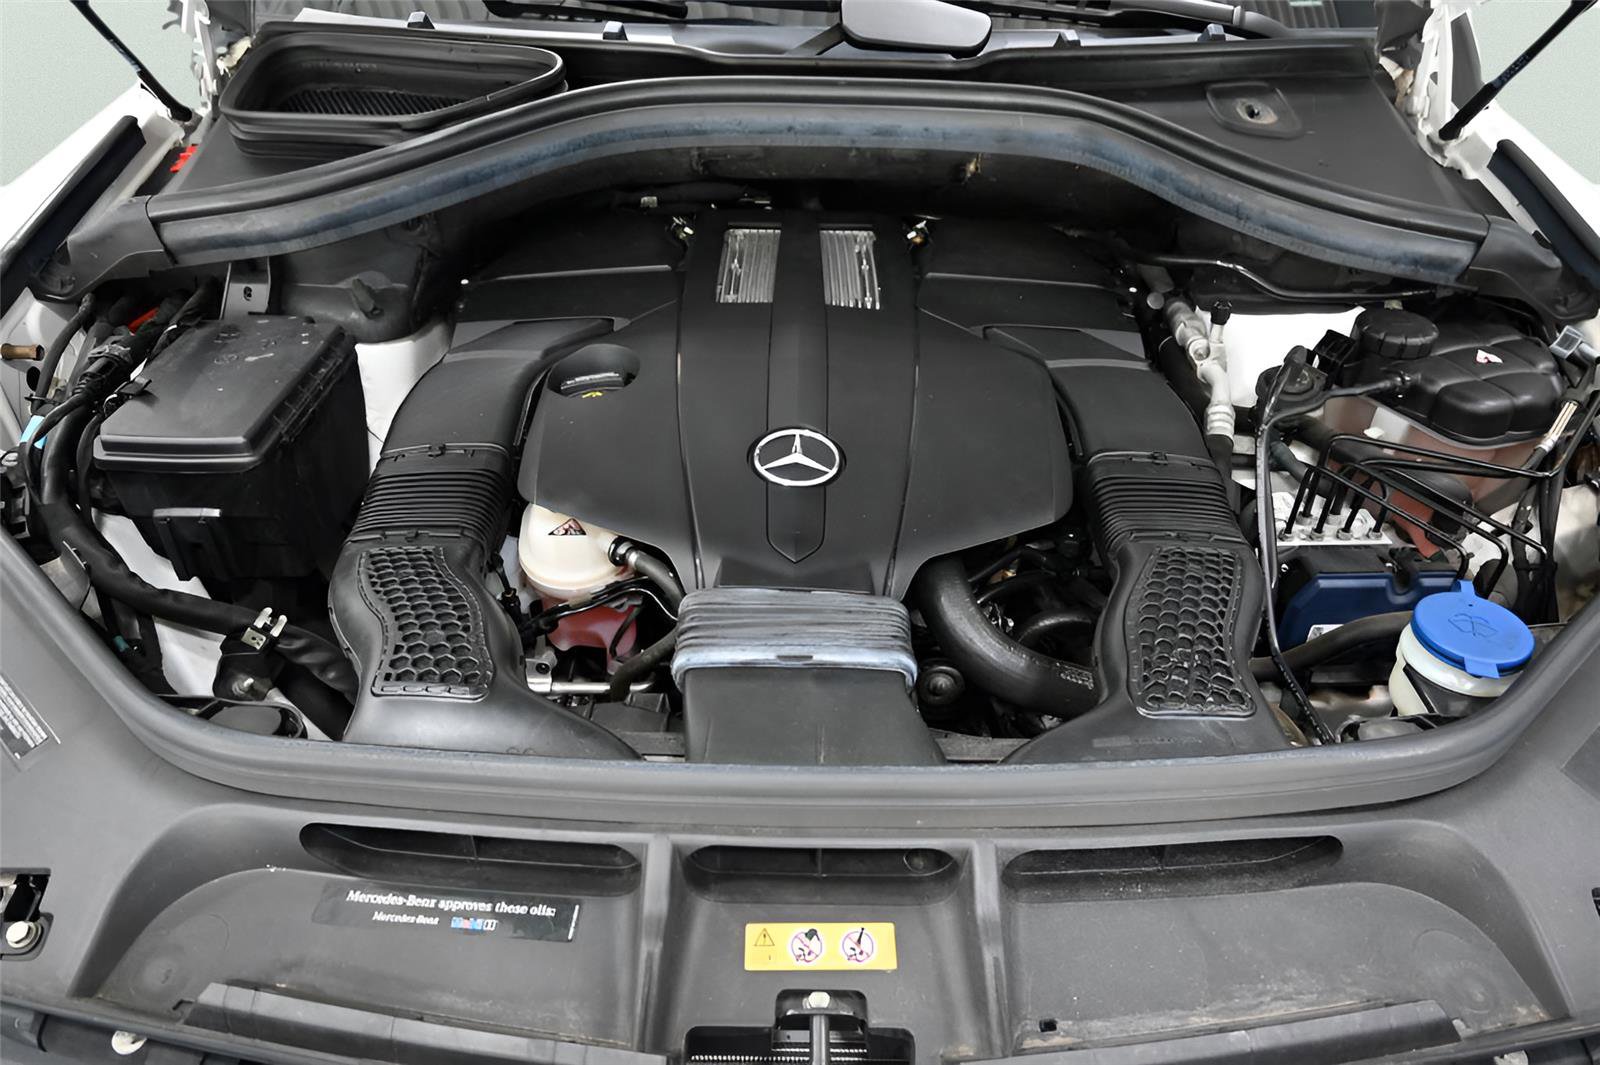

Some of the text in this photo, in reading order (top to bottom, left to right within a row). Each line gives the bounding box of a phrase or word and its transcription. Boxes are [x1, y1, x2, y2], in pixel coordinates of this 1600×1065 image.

[346, 890, 437, 908] Mercedes-Benz
[438, 899, 493, 912] approves
[495, 901, 528, 914] these
